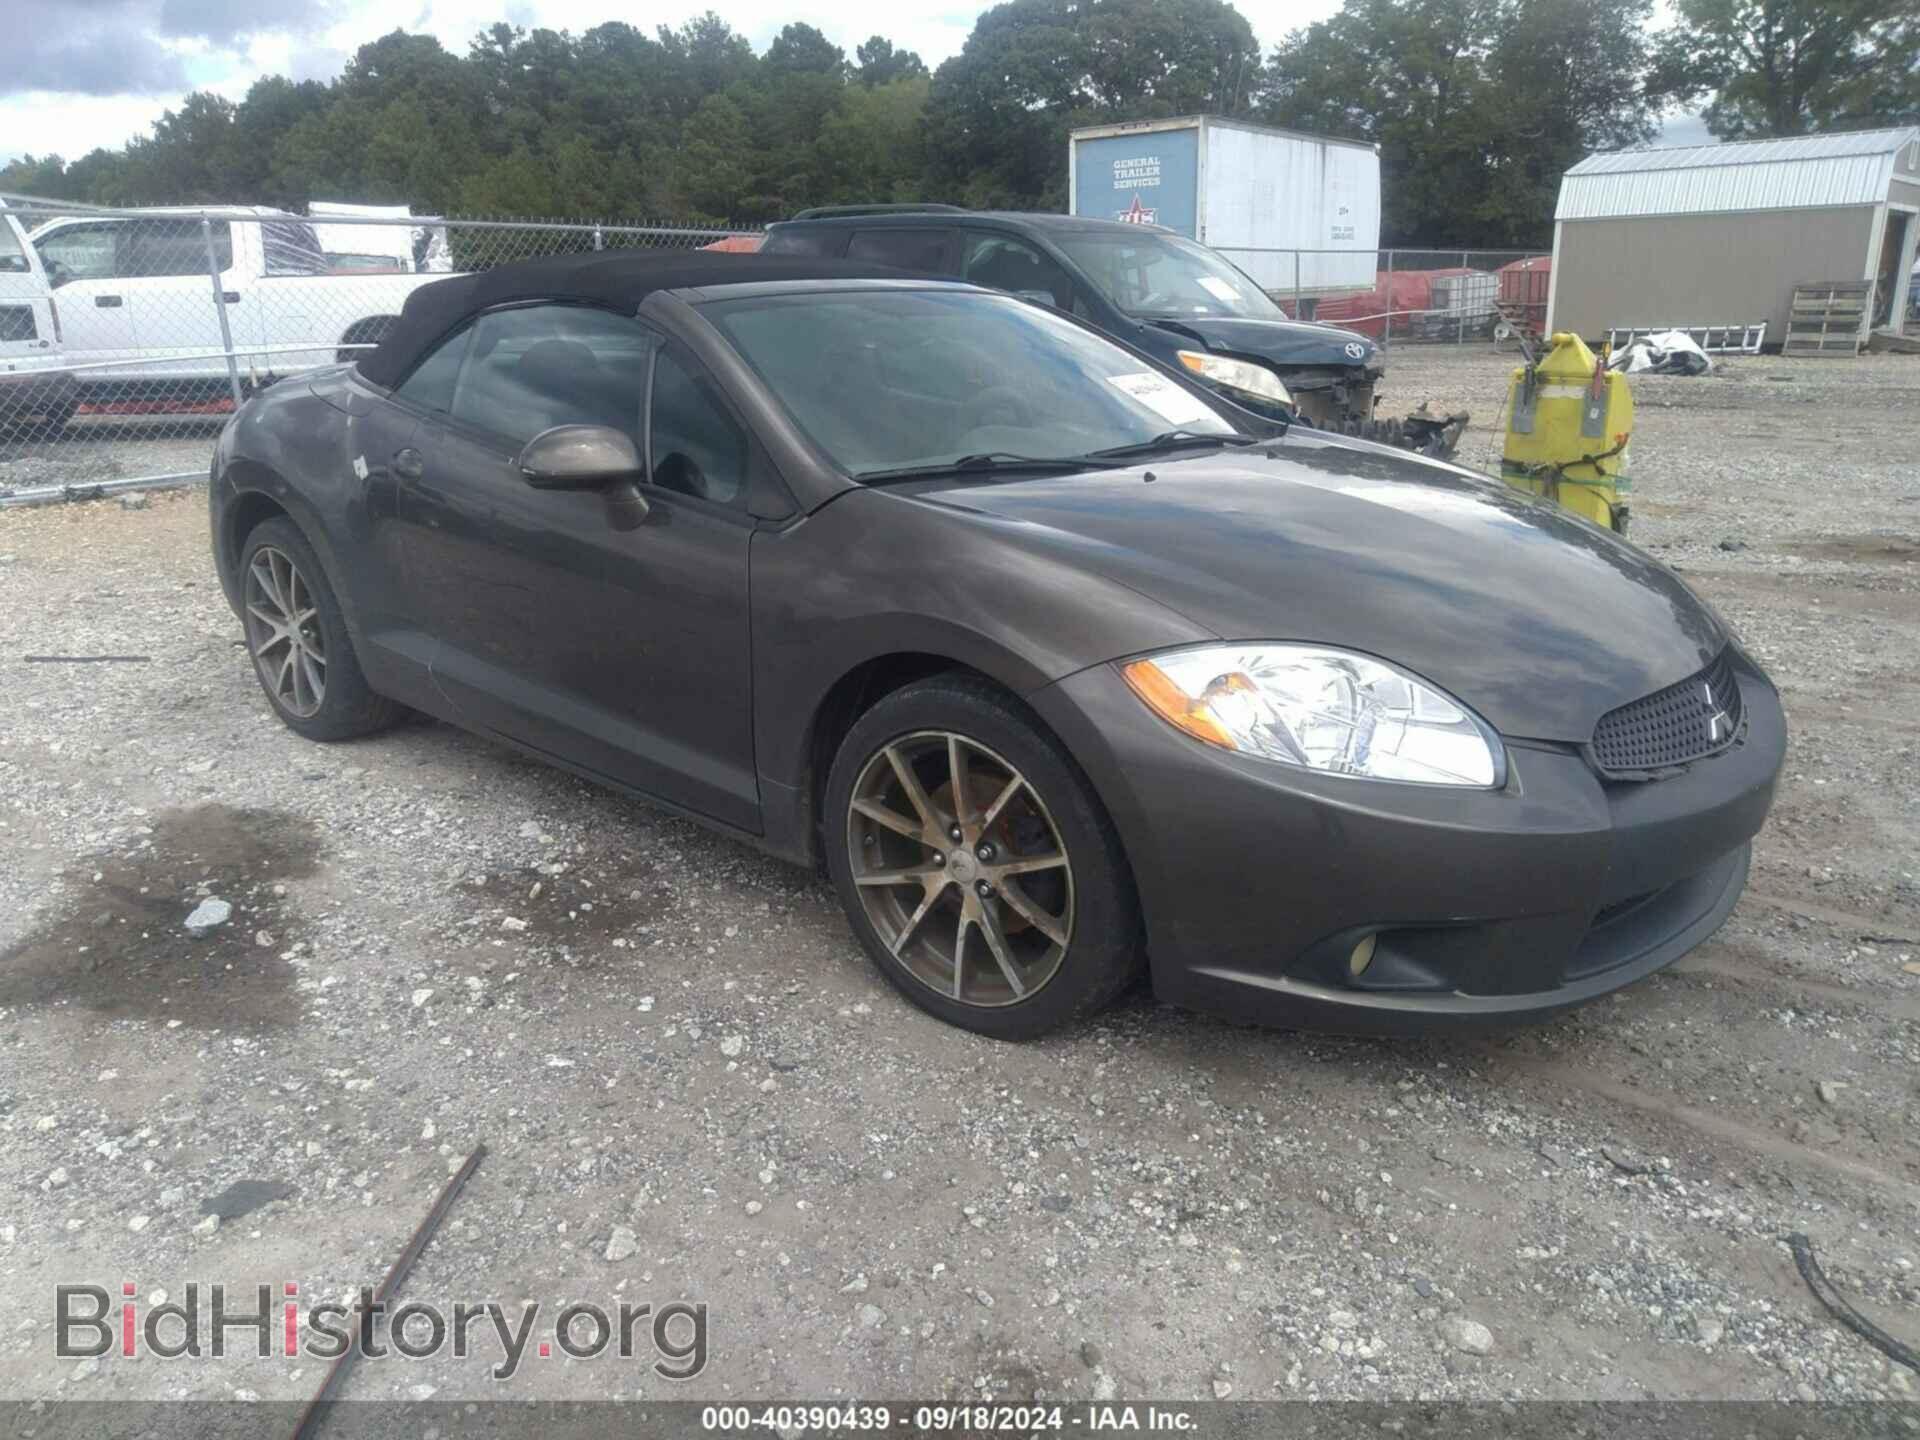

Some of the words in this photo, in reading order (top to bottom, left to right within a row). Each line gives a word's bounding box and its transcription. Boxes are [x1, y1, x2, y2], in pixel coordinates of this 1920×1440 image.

[1113, 157, 1160, 169] GENERAL
[1113, 167, 1160, 179] TRAILER
[1113, 177, 1160, 189] SERVICES
